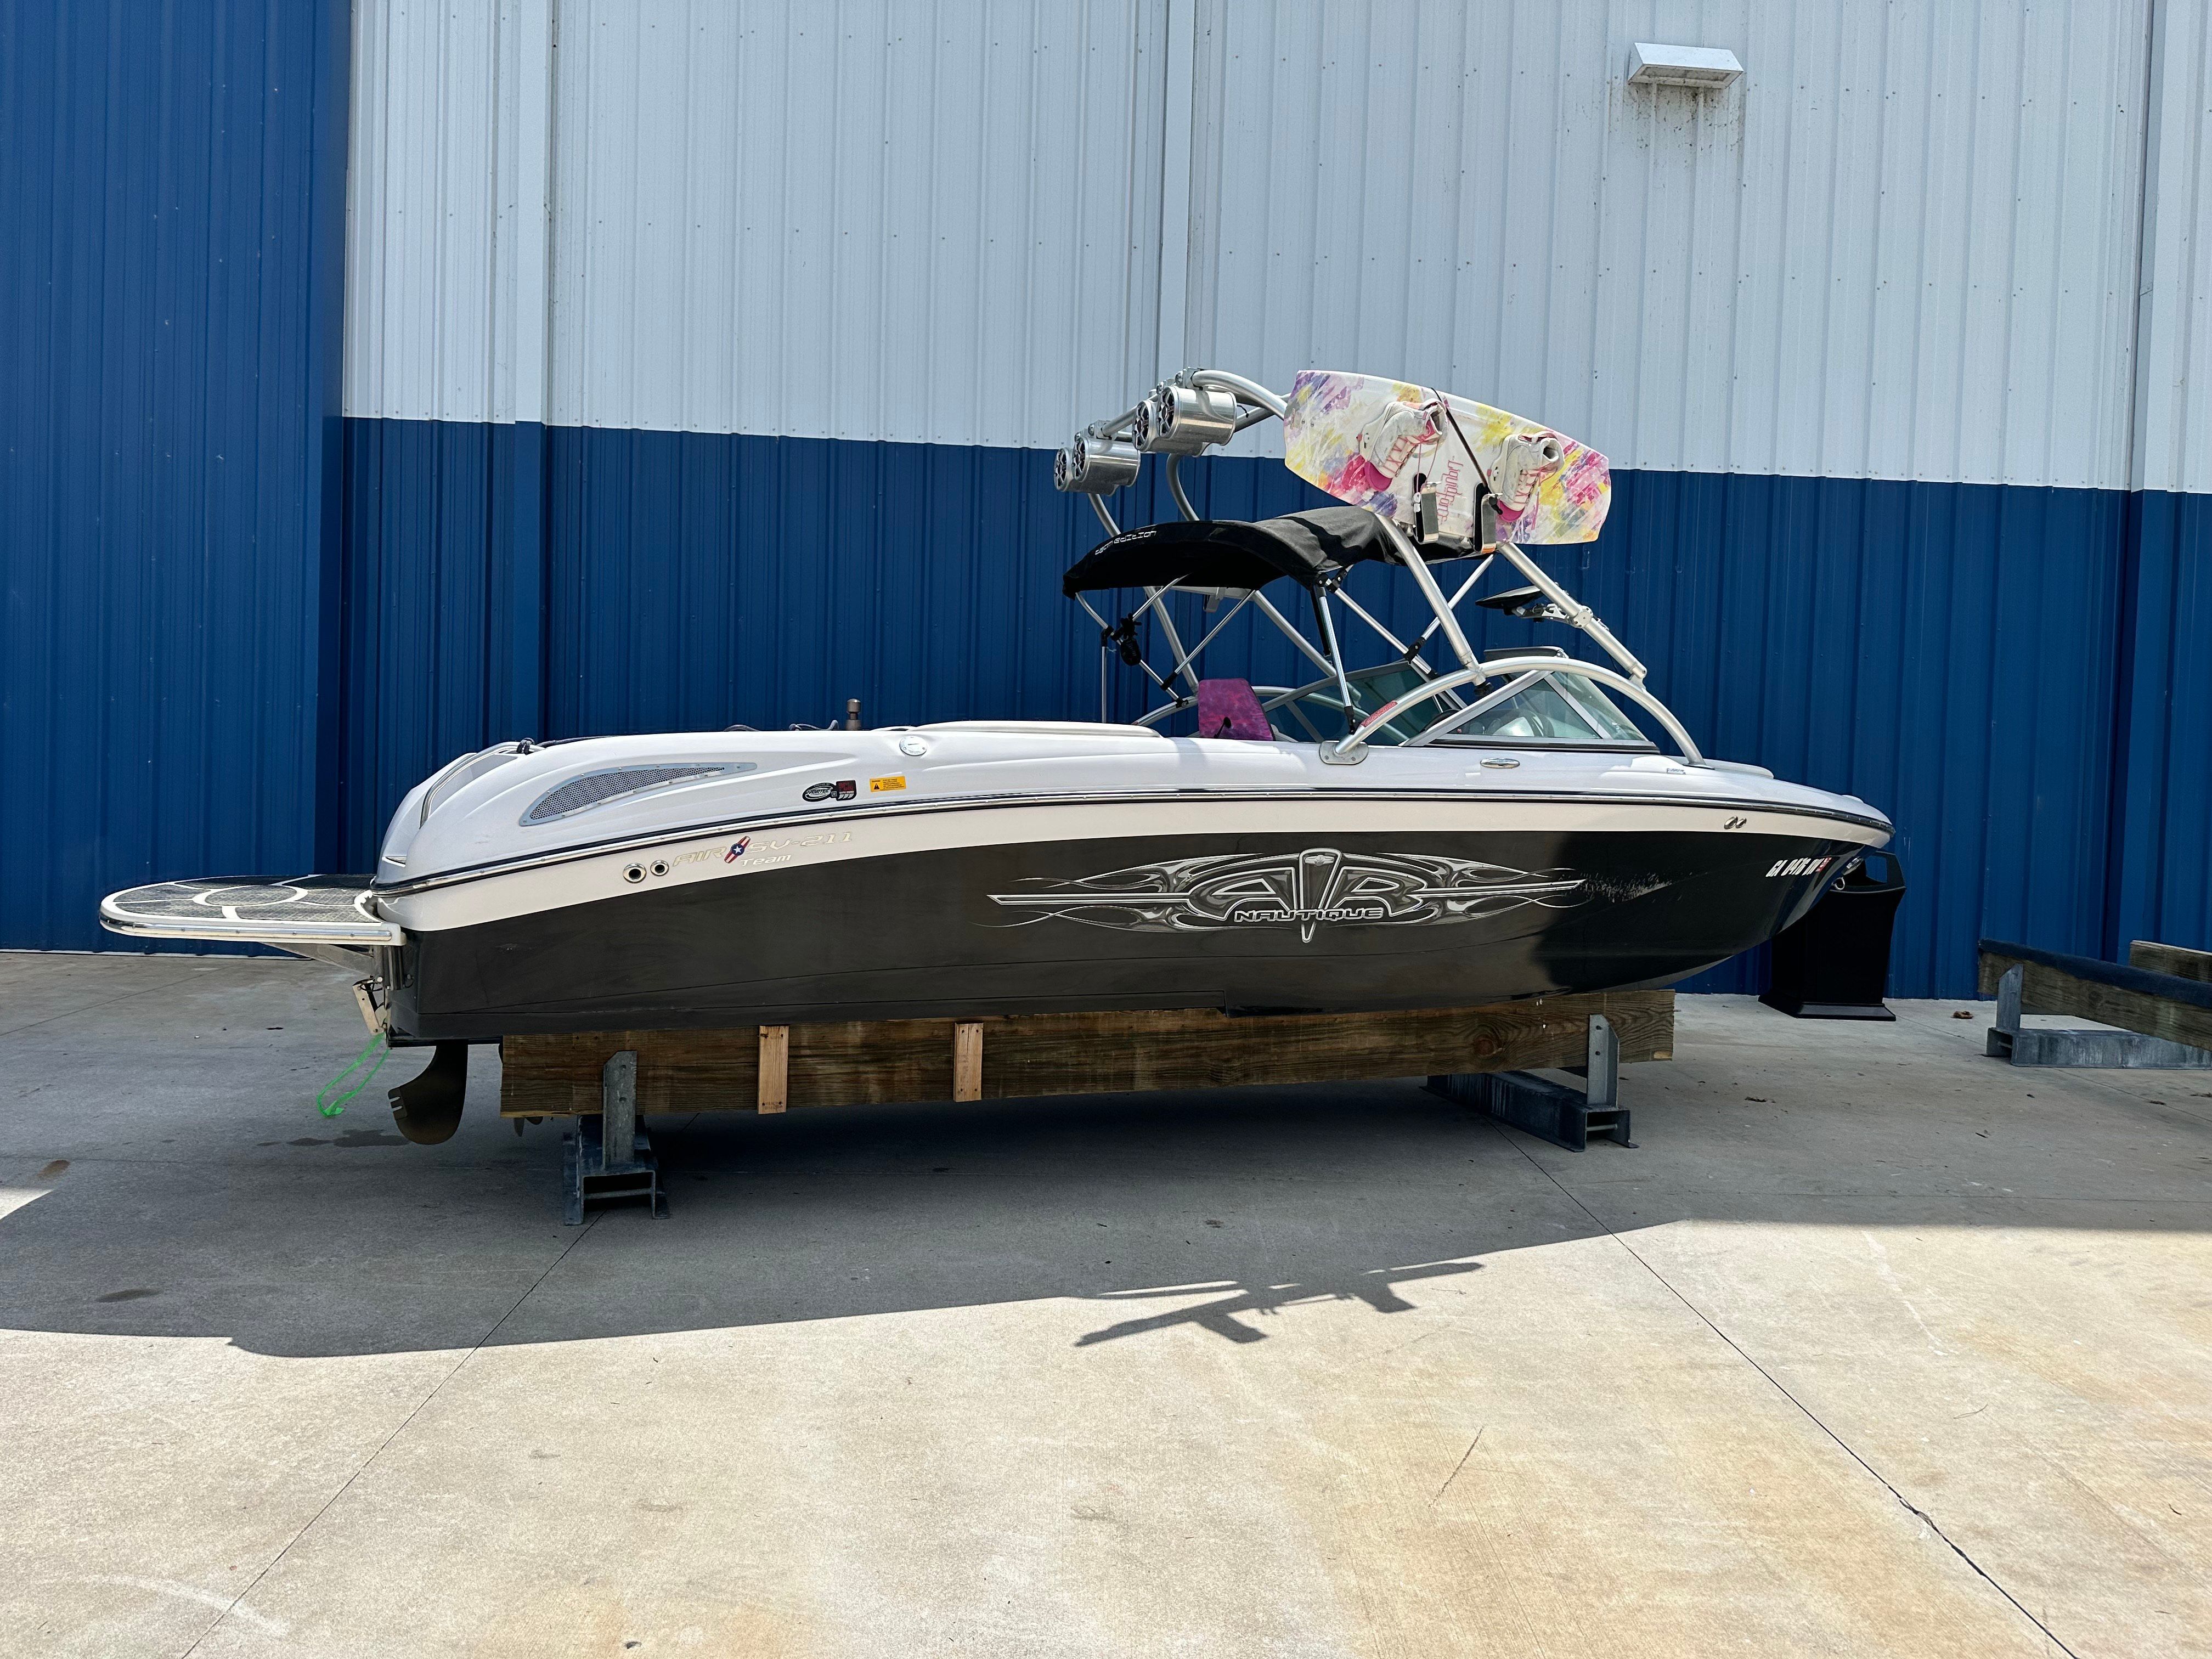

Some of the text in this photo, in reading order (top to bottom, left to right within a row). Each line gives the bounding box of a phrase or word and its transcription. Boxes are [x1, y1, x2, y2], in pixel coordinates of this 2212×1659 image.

[673, 832, 853, 867] AIR SV-211
[741, 854, 792, 867] Team
[1765, 859, 1788, 877] GA
[1234, 907, 1383, 922] NAUTIQUE
